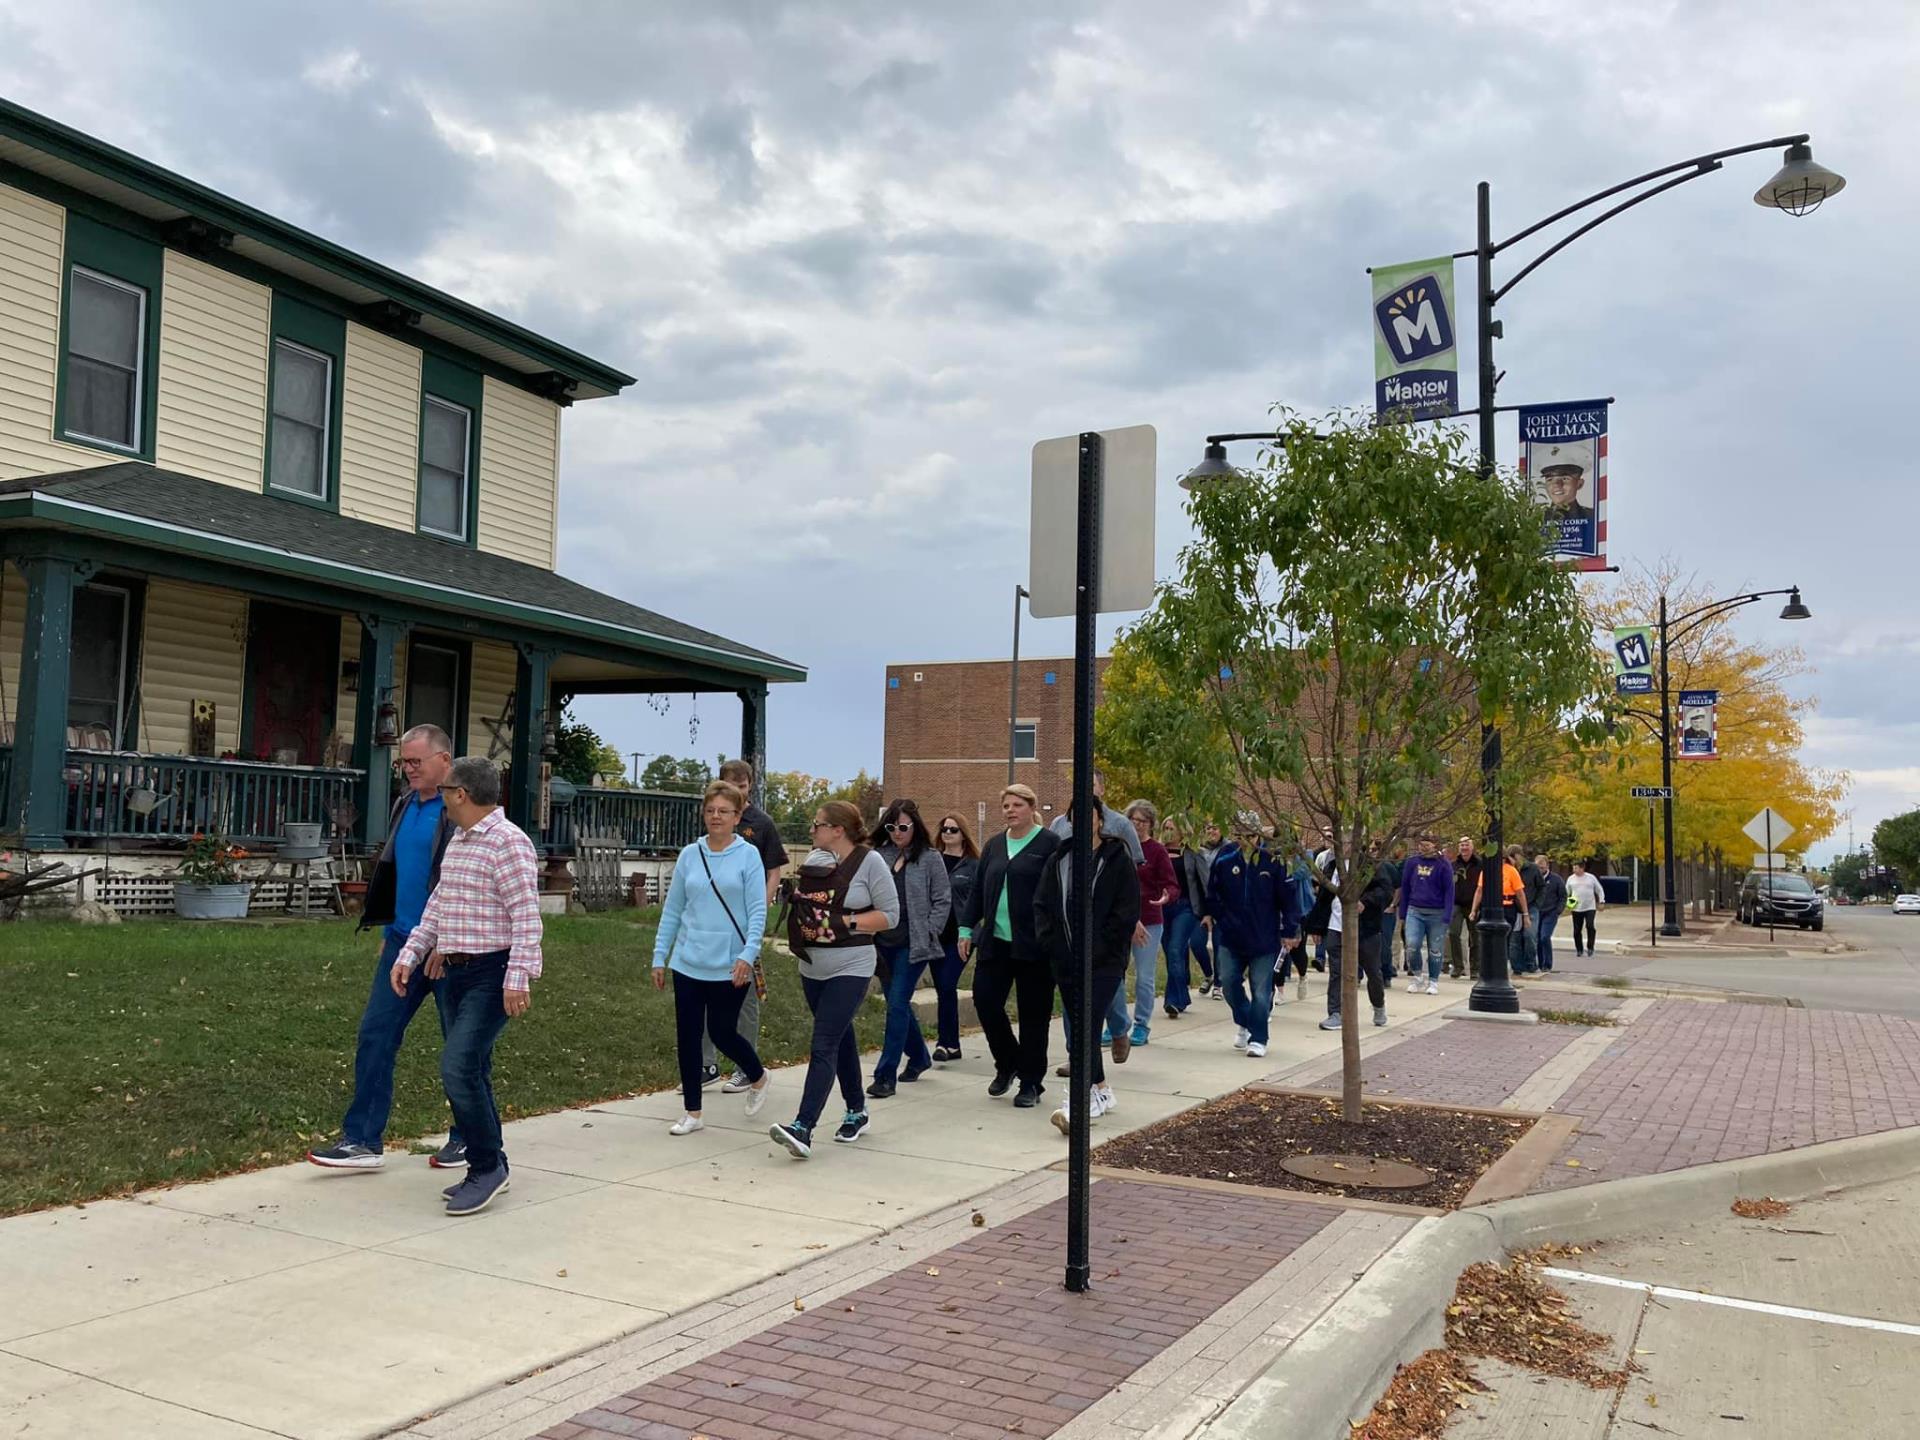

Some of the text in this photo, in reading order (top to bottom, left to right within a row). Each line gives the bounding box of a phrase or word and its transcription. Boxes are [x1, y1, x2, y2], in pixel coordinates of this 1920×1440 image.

[1392, 299, 1442, 355] M
[1525, 422, 1601, 439] WILLMAN
[1527, 414, 1560, 427] JOHN
[1623, 643, 1645, 666] M
